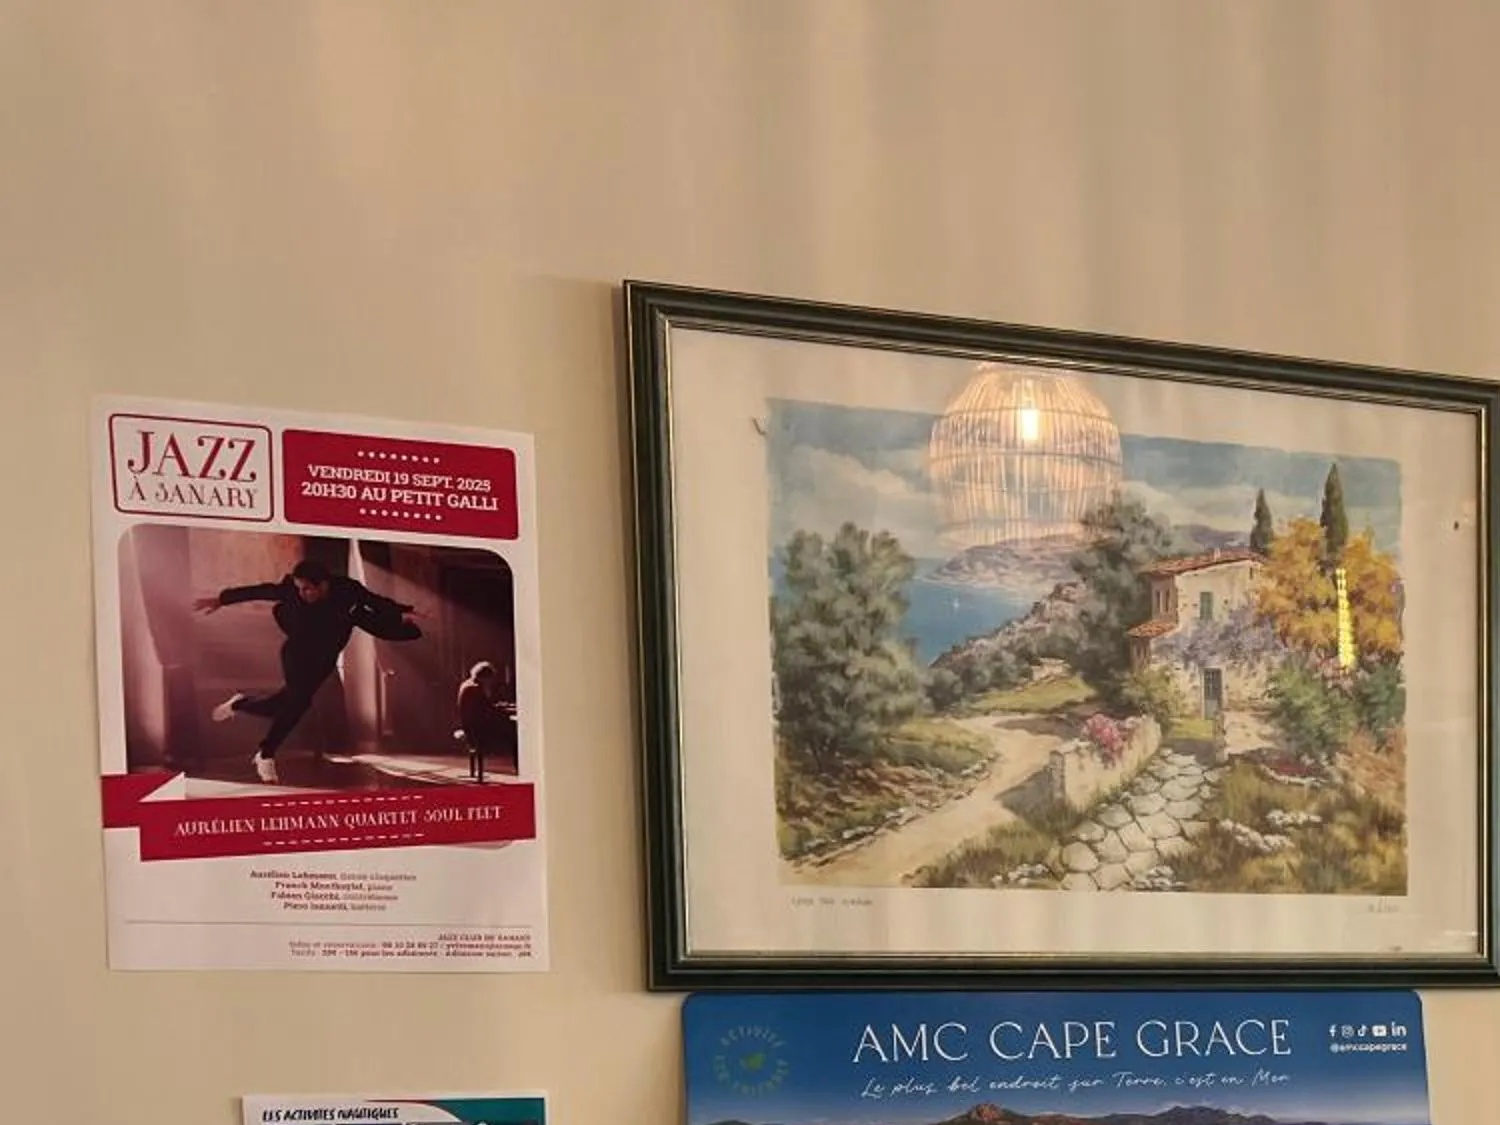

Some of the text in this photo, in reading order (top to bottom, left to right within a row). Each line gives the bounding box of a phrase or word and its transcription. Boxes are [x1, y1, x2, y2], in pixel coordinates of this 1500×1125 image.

[128, 430, 257, 482] JAZZ
[308, 464, 491, 491] VENDREDI 19 SEPT. 2025
[301, 482, 498, 511] 20H30 AU PETIT GALLI
[261, 815, 340, 832] LEHMANN
[344, 809, 418, 831] QUARTET
[852, 1019, 1292, 1064] AMC CAPE GRACE
[891, 1077, 938, 1096] plus
[988, 1074, 1061, 1091] endroit
